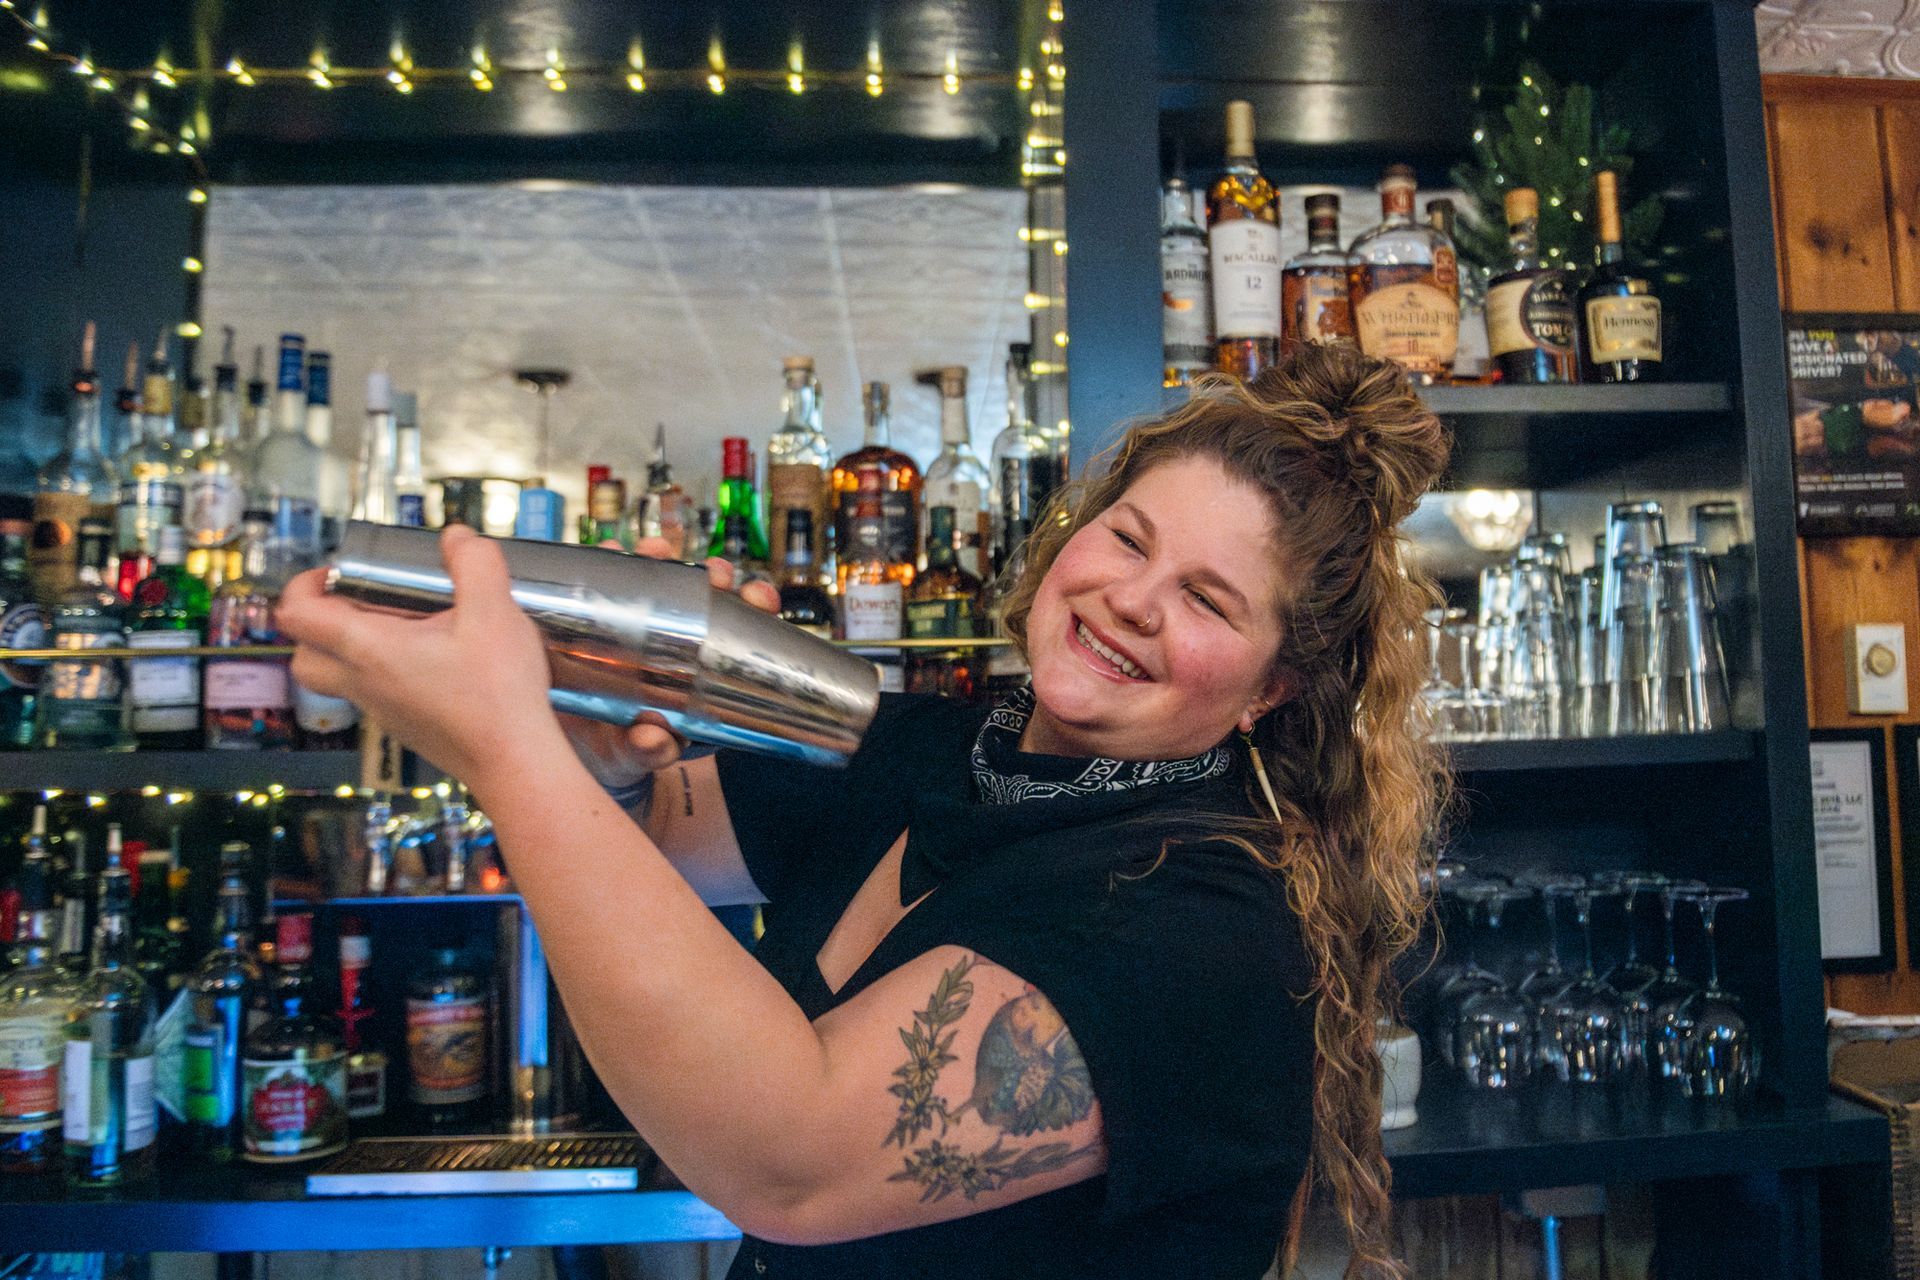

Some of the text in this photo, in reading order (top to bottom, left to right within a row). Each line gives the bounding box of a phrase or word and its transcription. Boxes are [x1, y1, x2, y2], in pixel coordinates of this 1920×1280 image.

[1247, 275, 1262, 289] 12
[1604, 317, 1655, 330] Hennessy
[1790, 352, 1867, 366] DESIGNATED
